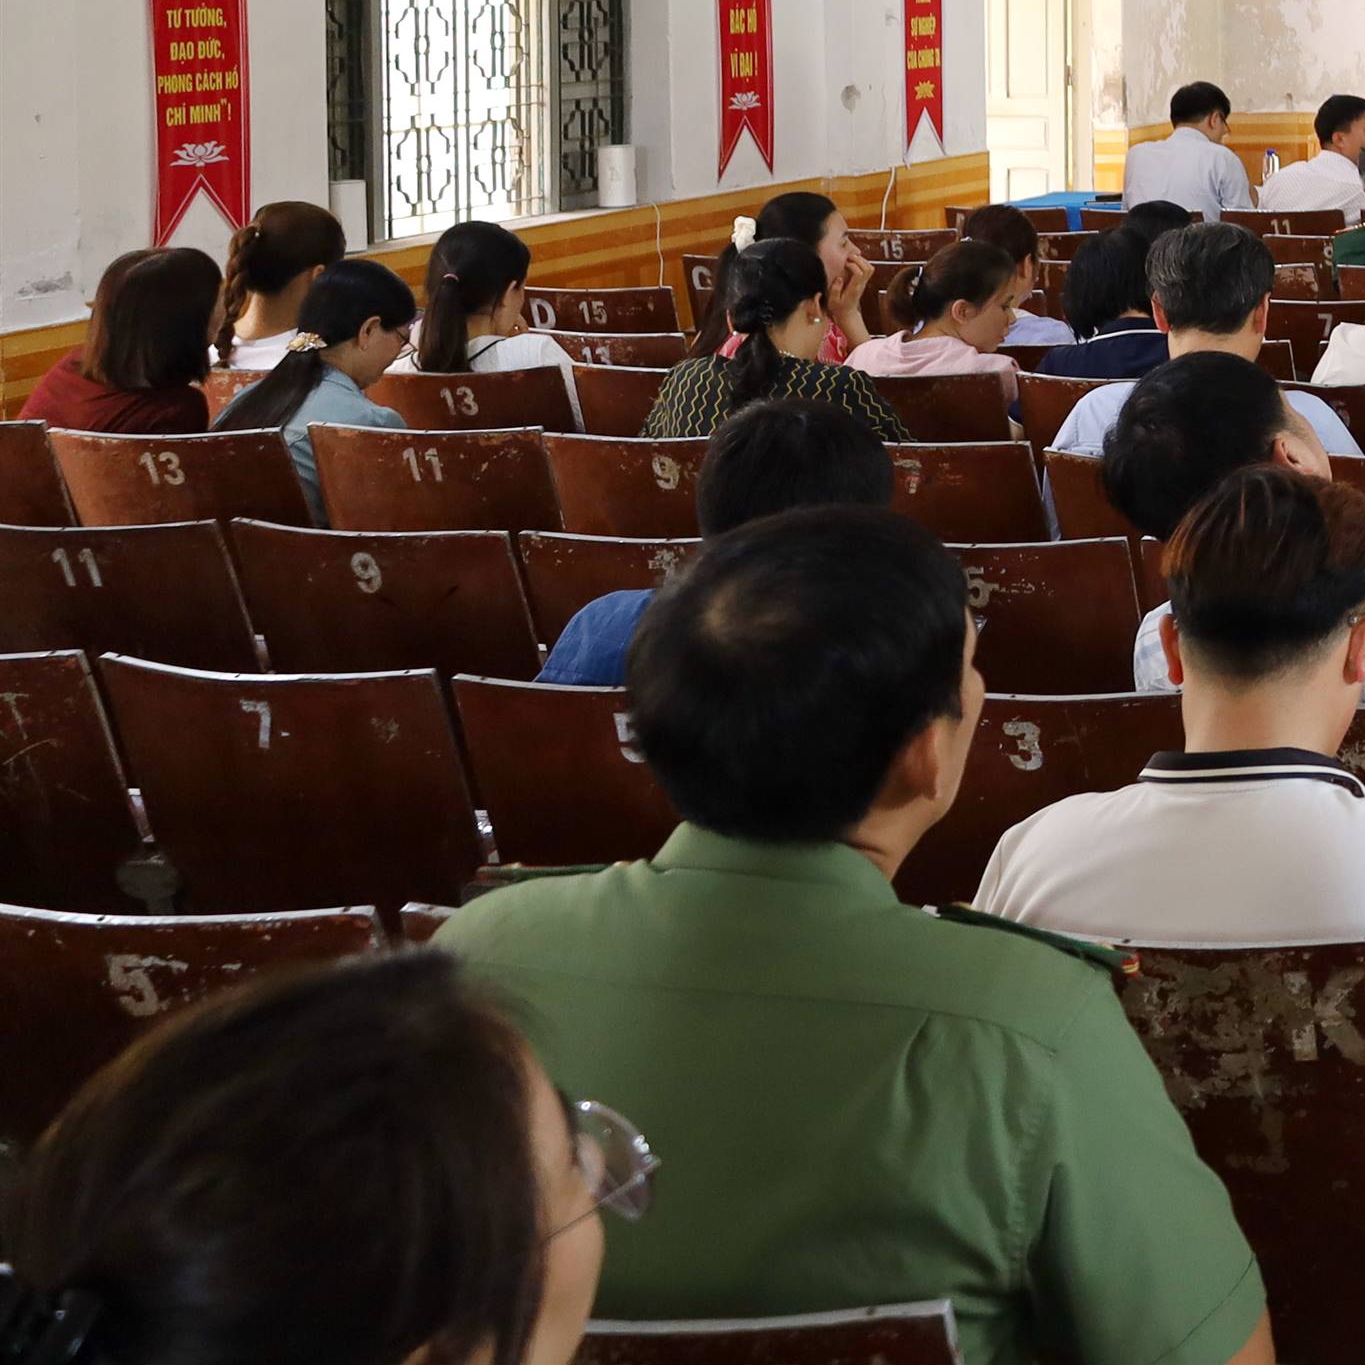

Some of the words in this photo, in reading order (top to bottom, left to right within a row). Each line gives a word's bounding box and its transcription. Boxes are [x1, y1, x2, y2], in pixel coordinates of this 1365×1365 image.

[880, 239, 903, 263] 15
[530, 299, 555, 331] D
[579, 301, 607, 323] 15
[441, 386, 478, 415] 13
[139, 452, 184, 485] 13
[403, 448, 443, 481] 11
[52, 548, 102, 586] 11
[351, 552, 381, 593] 9
[1003, 722, 1042, 770] 3
